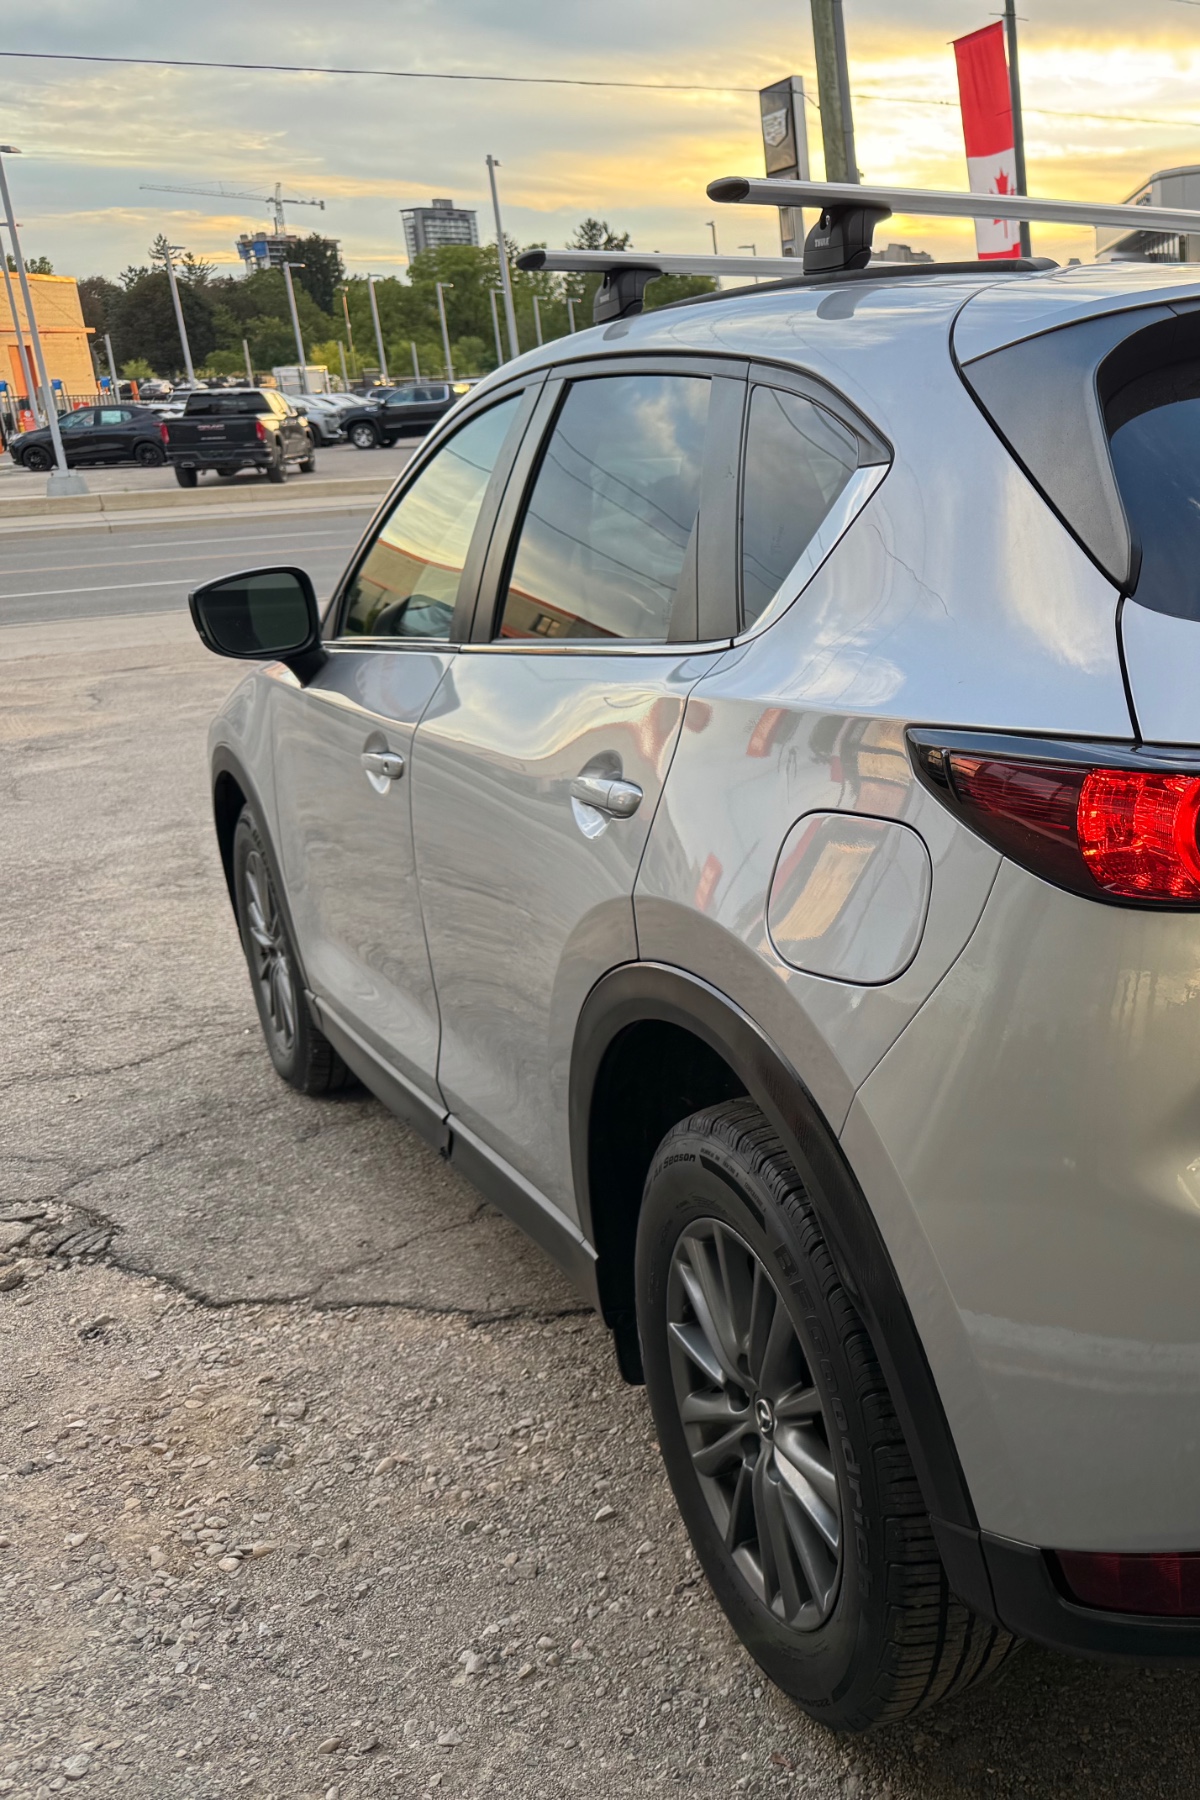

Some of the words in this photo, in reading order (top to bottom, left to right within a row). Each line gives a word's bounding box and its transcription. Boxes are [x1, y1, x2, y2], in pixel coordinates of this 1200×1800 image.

[814, 236, 831, 248] THULE
[662, 1152, 697, 1169] Season
[772, 1242, 875, 1601] BFGoodrich
